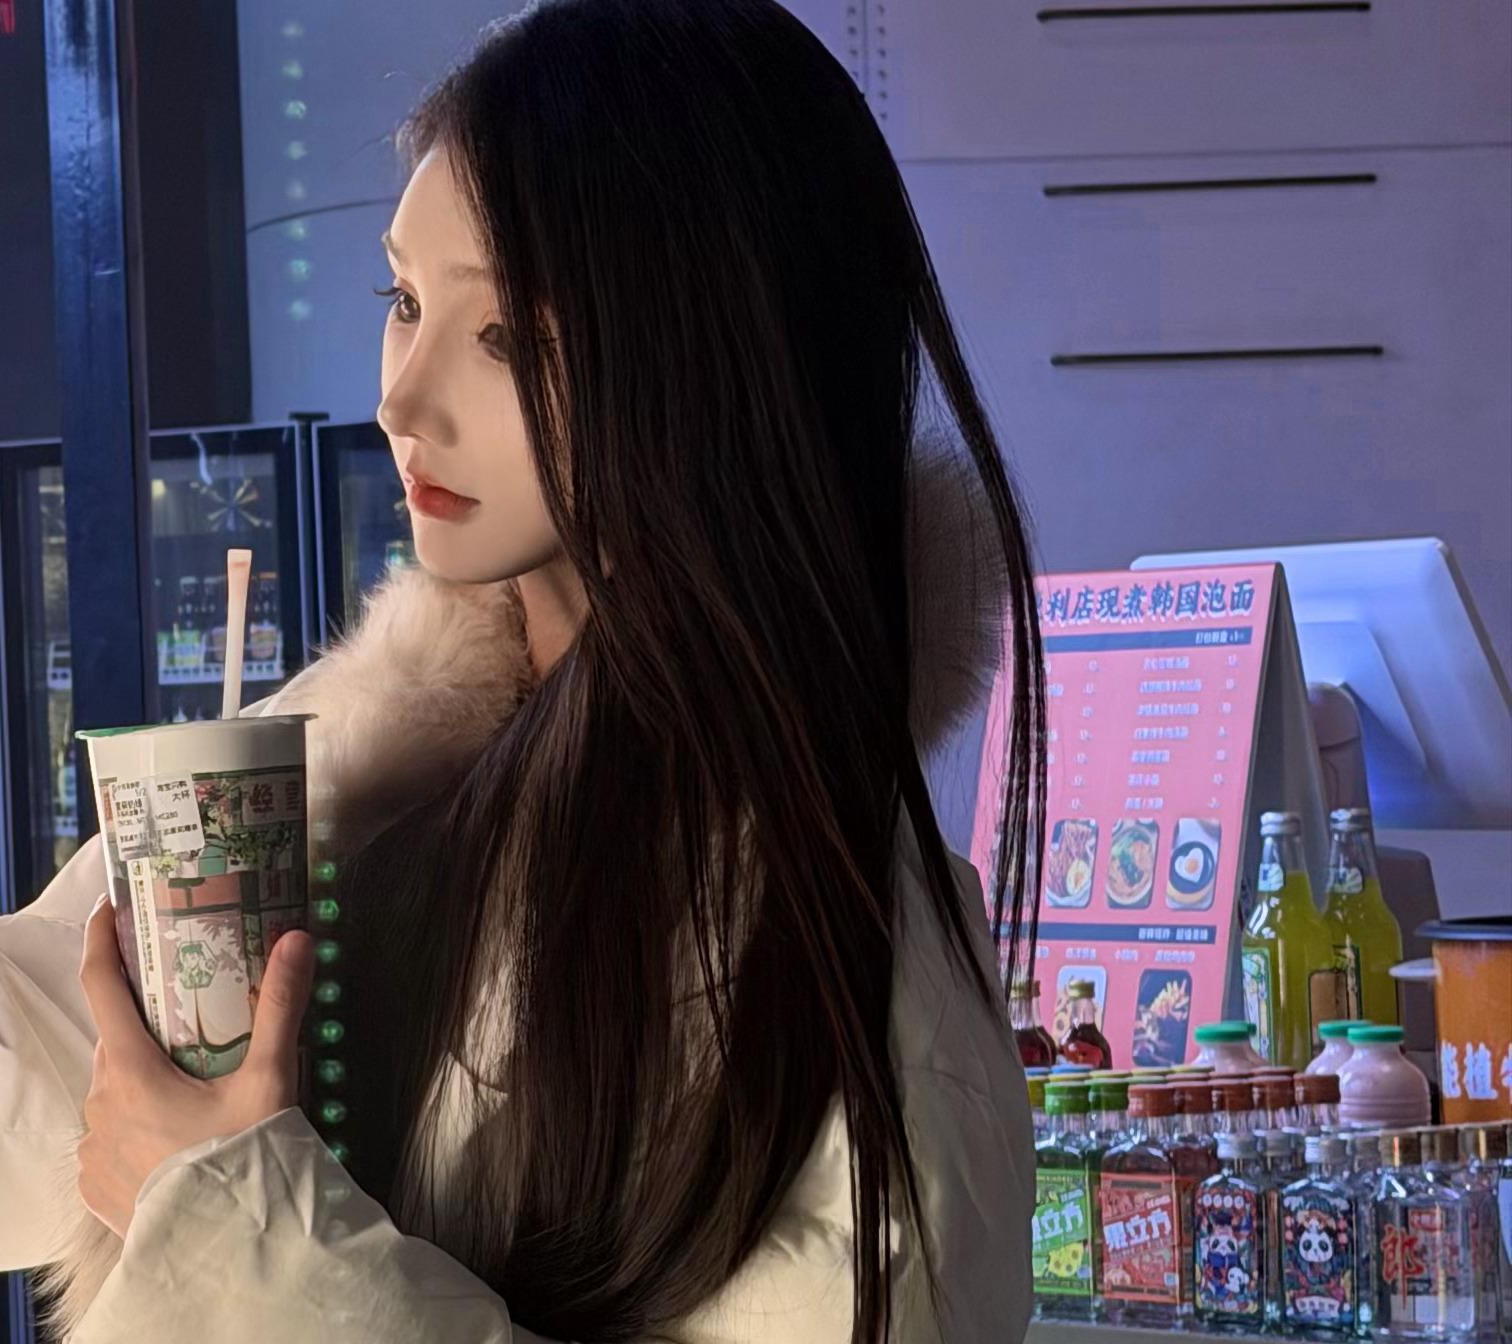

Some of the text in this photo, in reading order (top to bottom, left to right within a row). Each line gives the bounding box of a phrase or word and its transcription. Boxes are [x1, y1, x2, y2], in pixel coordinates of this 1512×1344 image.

[1037, 580, 1255, 627] 利店现煮韩国泡面
[1103, 1208, 1172, 1250] 果立方
